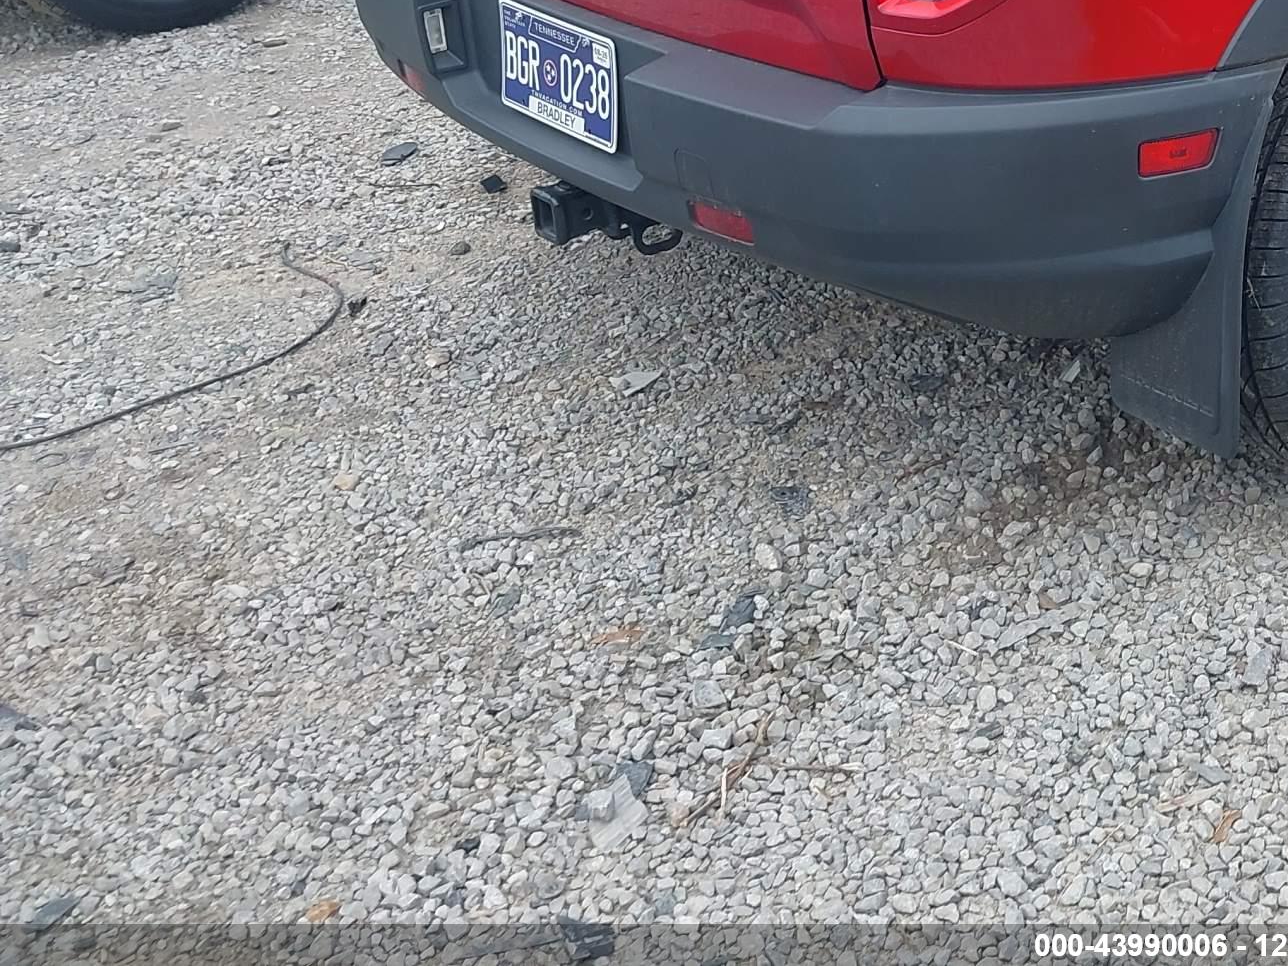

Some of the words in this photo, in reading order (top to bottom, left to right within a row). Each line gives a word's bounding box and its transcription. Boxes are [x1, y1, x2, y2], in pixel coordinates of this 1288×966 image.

[534, 21, 576, 46] TENNESSEE
[505, 31, 540, 91] BGR
[559, 53, 610, 120] 0238
[537, 101, 576, 129] BRADLEY
